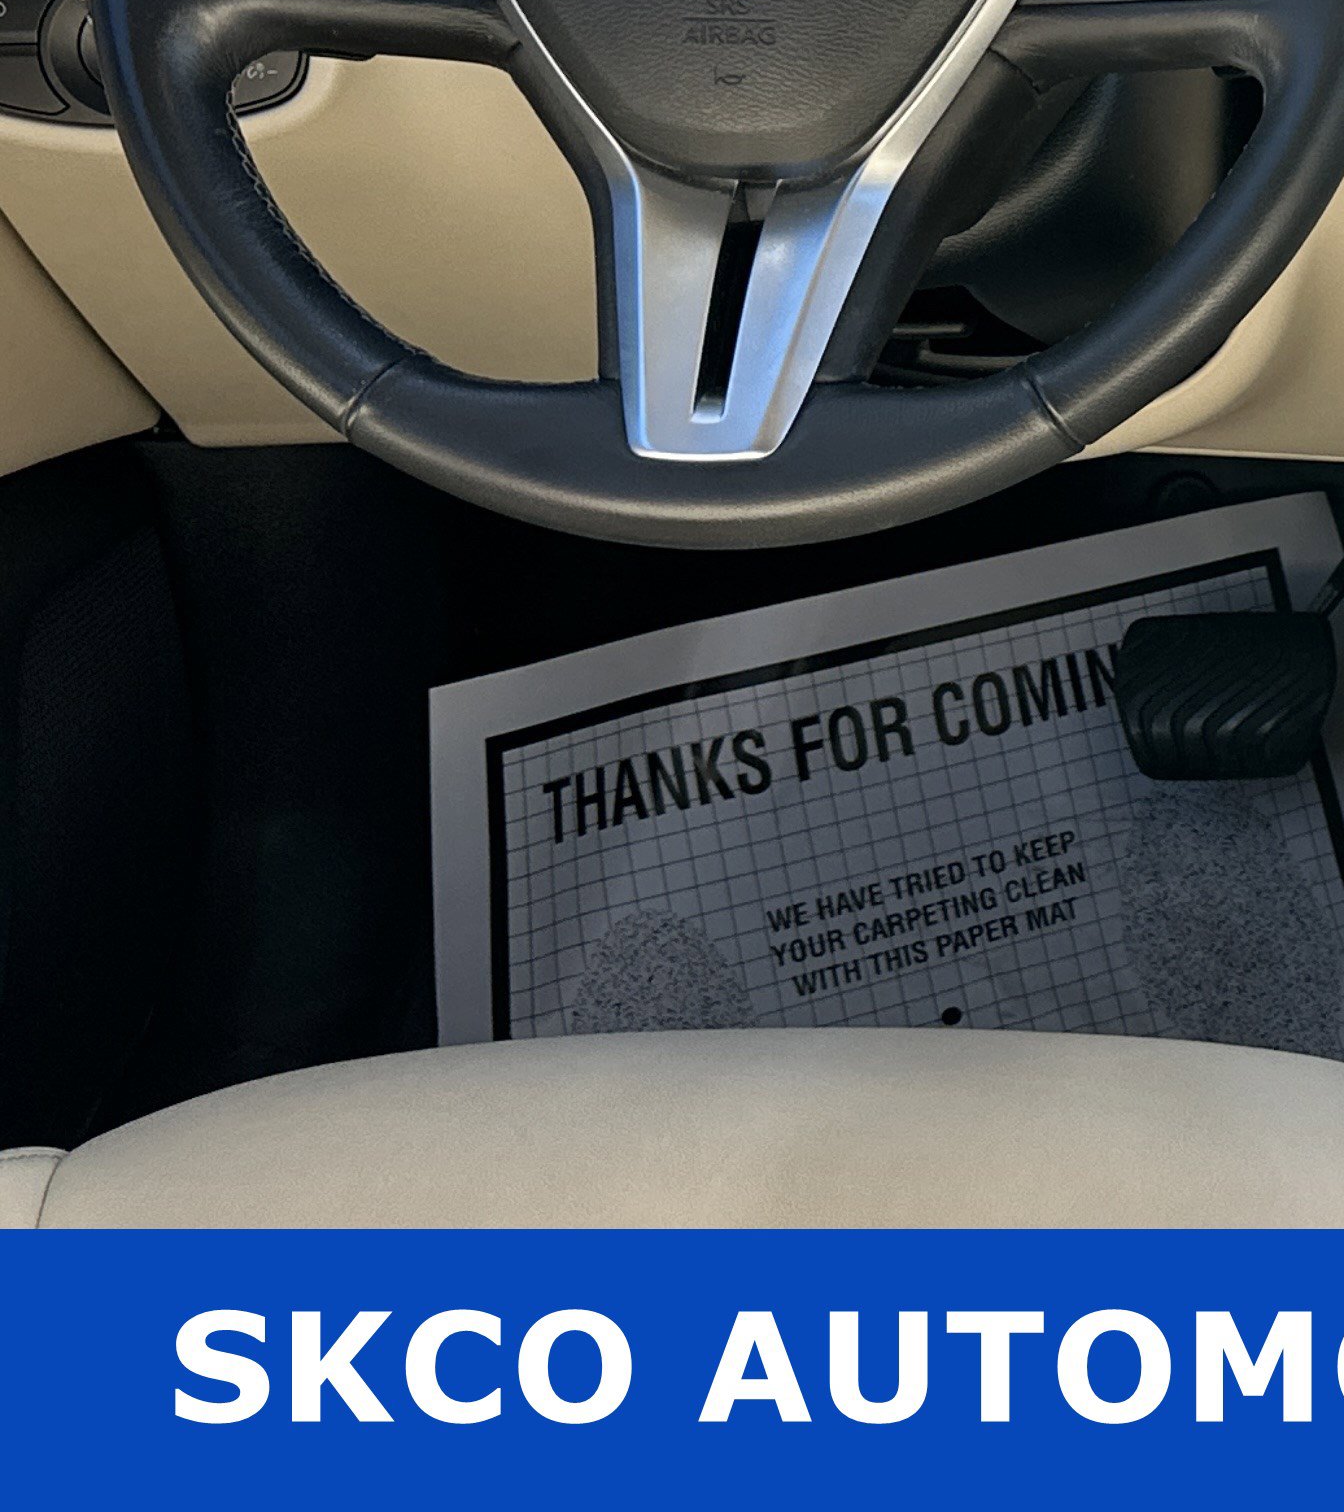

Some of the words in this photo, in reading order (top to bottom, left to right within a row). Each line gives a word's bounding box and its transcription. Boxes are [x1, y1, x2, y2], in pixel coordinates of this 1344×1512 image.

[681, 24, 777, 46] AIRBAG
[543, 728, 772, 844] THANKS
[790, 696, 914, 782] FOR
[766, 901, 811, 933] WE
[816, 883, 884, 920] HAVE
[889, 861, 966, 901] TRIED
[971, 849, 1007, 877] TO
[1013, 830, 1076, 867] KEEP
[770, 928, 846, 968] YOUR
[852, 887, 999, 946] CARPETING
[1005, 862, 1087, 903] CLEAN
[792, 959, 863, 997] WITH
[868, 940, 930, 976] THIS
[936, 914, 1020, 958] PAPER
[1025, 896, 1081, 932] MAT
